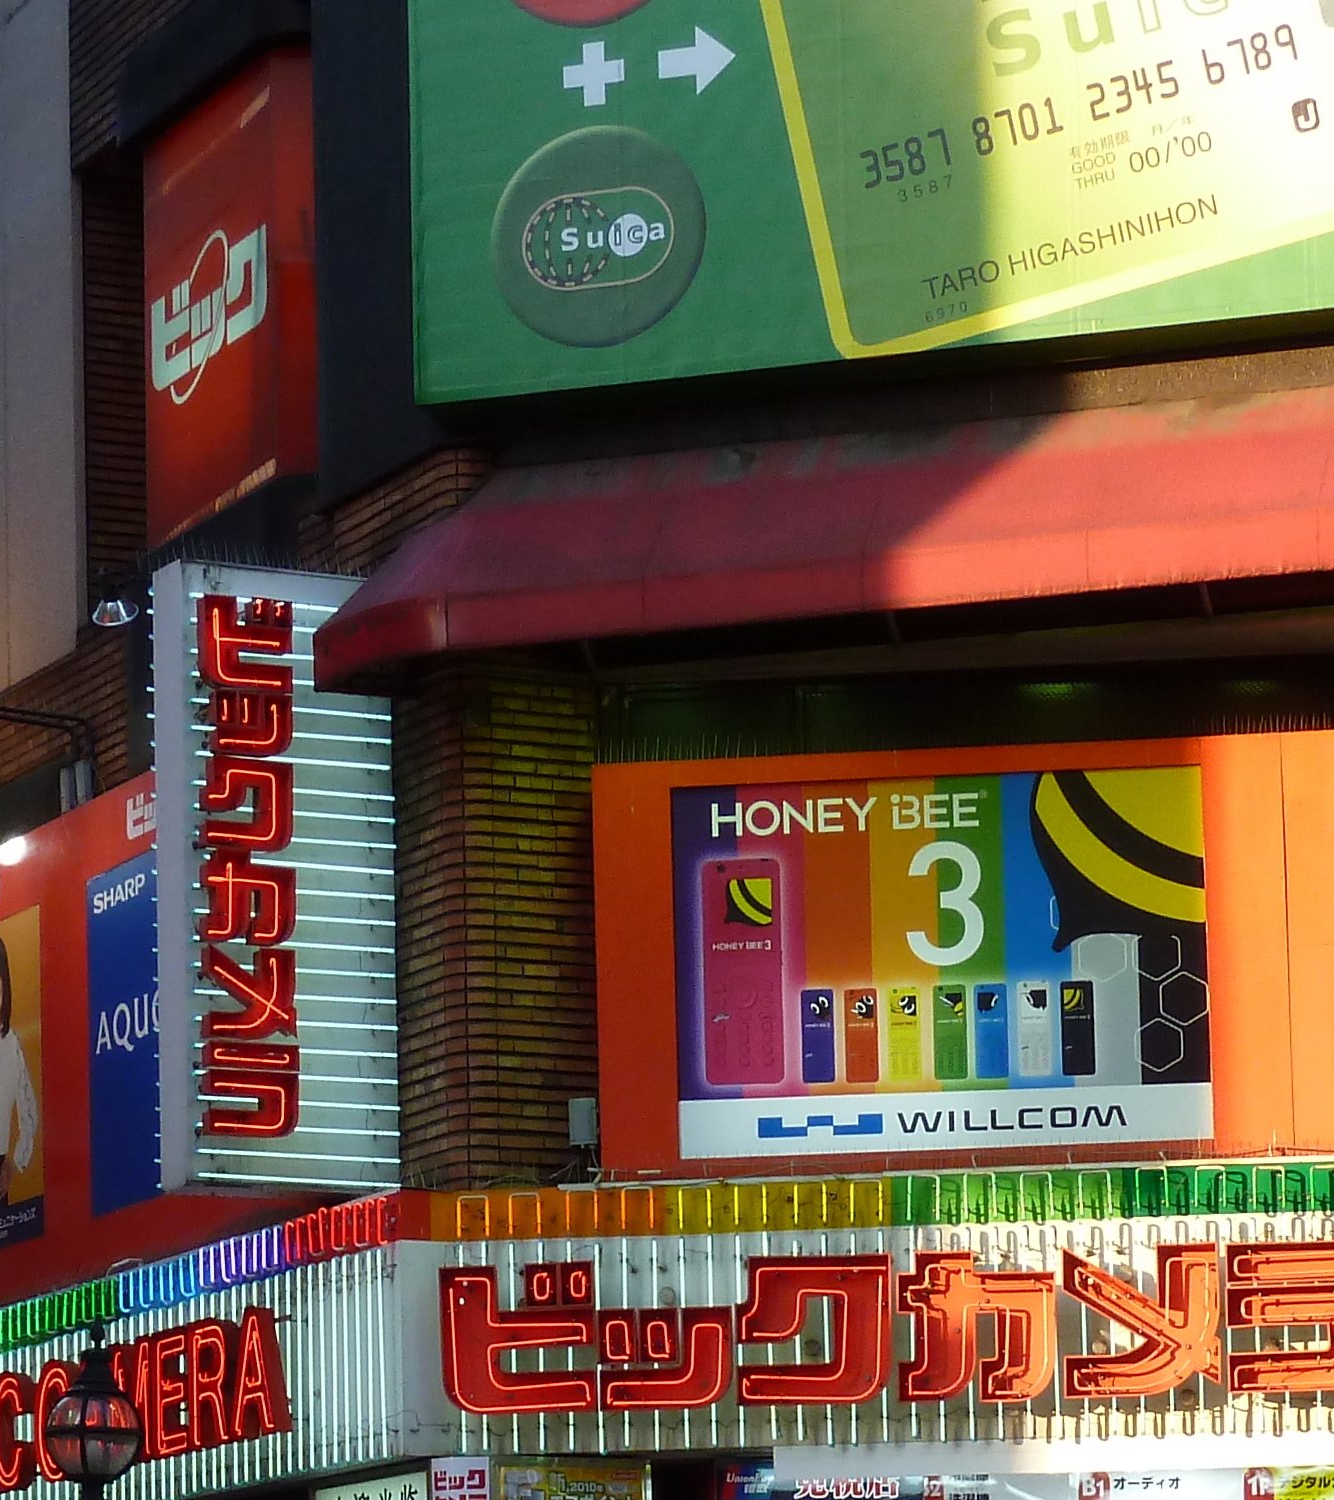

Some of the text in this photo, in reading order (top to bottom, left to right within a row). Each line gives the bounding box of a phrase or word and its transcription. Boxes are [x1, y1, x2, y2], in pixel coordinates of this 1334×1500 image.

[860, 24, 1299, 189] 3587 8701 2345 6789
[1068, 130, 1131, 160] 有効期限
[1071, 151, 1117, 175] GOOD
[897, 174, 953, 203] 3587
[1074, 169, 1116, 190] THRU
[560, 218, 665, 252] Suica
[922, 194, 1218, 299] TARO HIGASHINIHON
[924, 301, 968, 323] 6970
[710, 796, 877, 838] HONEY
[197, 595, 299, 1137] ビックカメラ
[92, 874, 146, 915] SHARP
[906, 841, 984, 966] 3
[712, 942, 743, 952] HONEY
[897, 1104, 1128, 1132] WILLCOM
[433, 1470, 487, 1491] ビック
[1082, 1473, 1105, 1497] B1
[1114, 1476, 1181, 1490] オーディオ
[1247, 1472, 1273, 1496] 1F
